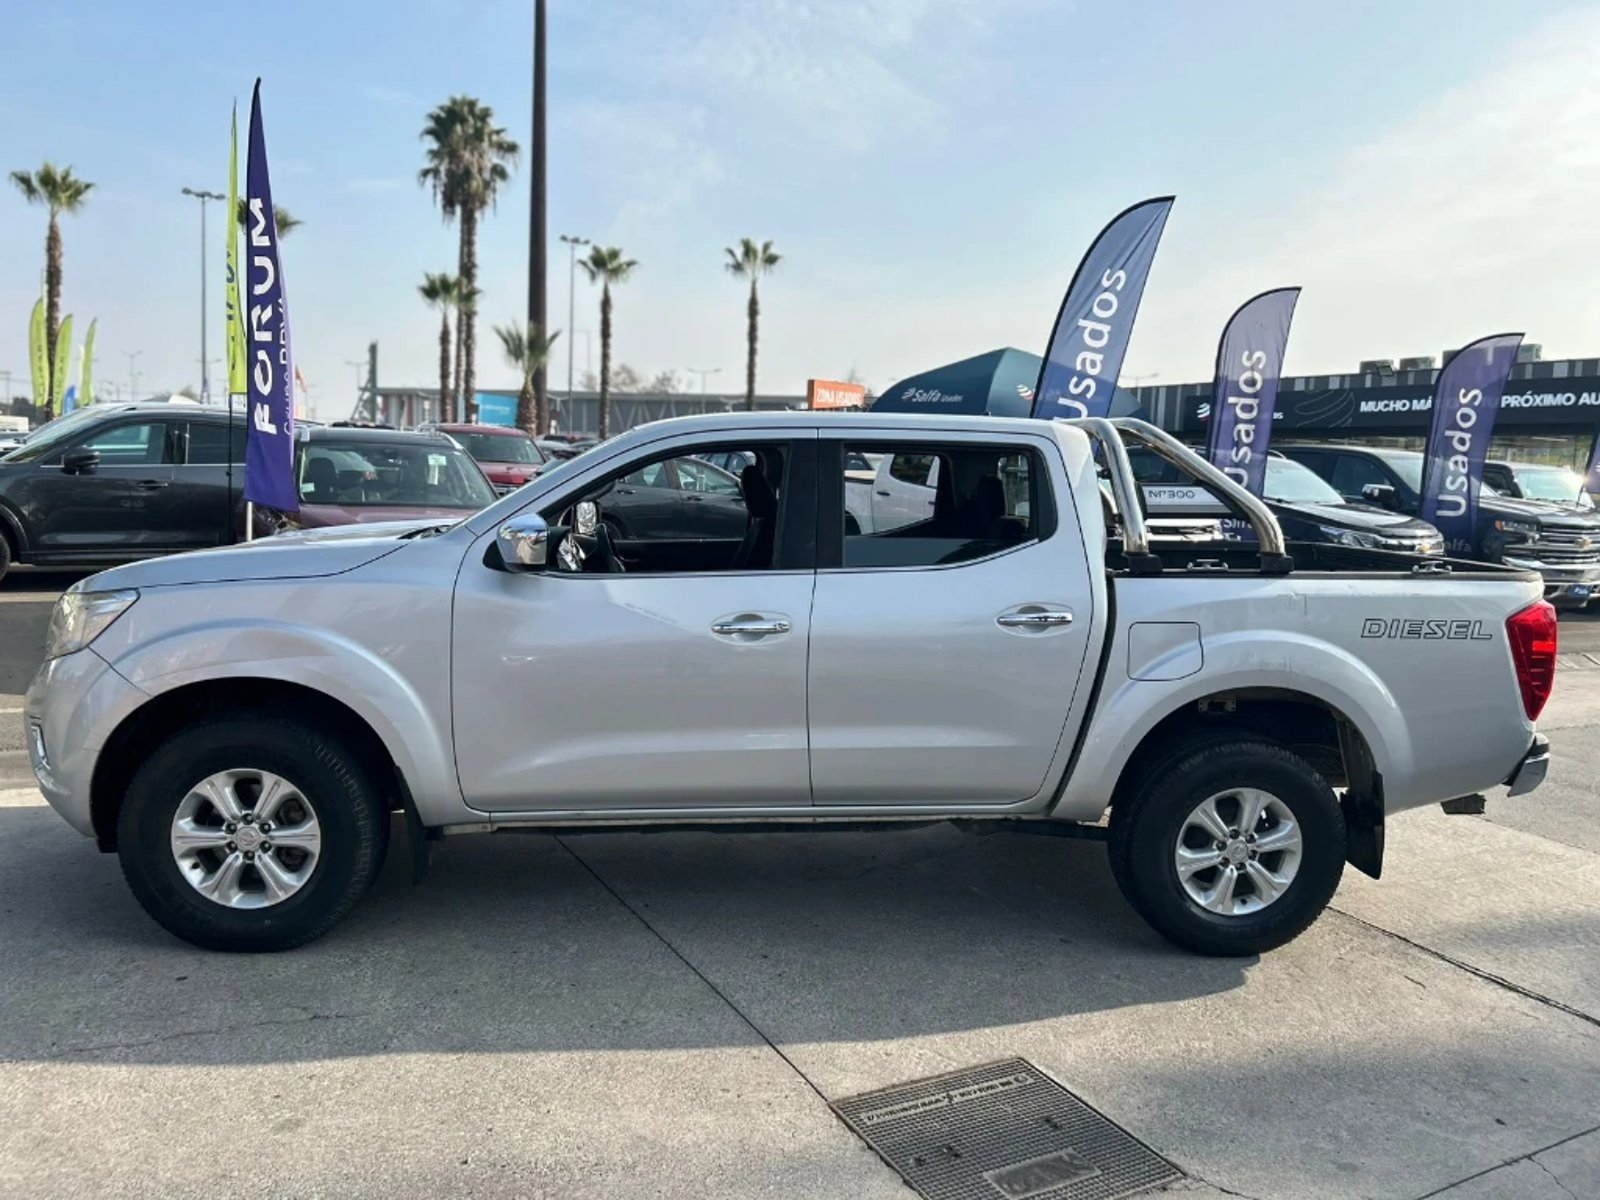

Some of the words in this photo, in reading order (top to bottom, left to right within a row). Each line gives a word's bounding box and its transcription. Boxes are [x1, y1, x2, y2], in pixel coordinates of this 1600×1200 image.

[249, 198, 277, 435] FORUM
[1053, 268, 1127, 422] Usados
[1224, 350, 1267, 489] Usados
[1360, 399, 1410, 412] MUCHO
[1501, 391, 1577, 408] PRÓXIMO
[1436, 387, 1483, 517] Usados
[1360, 618, 1493, 640] DIESEL
